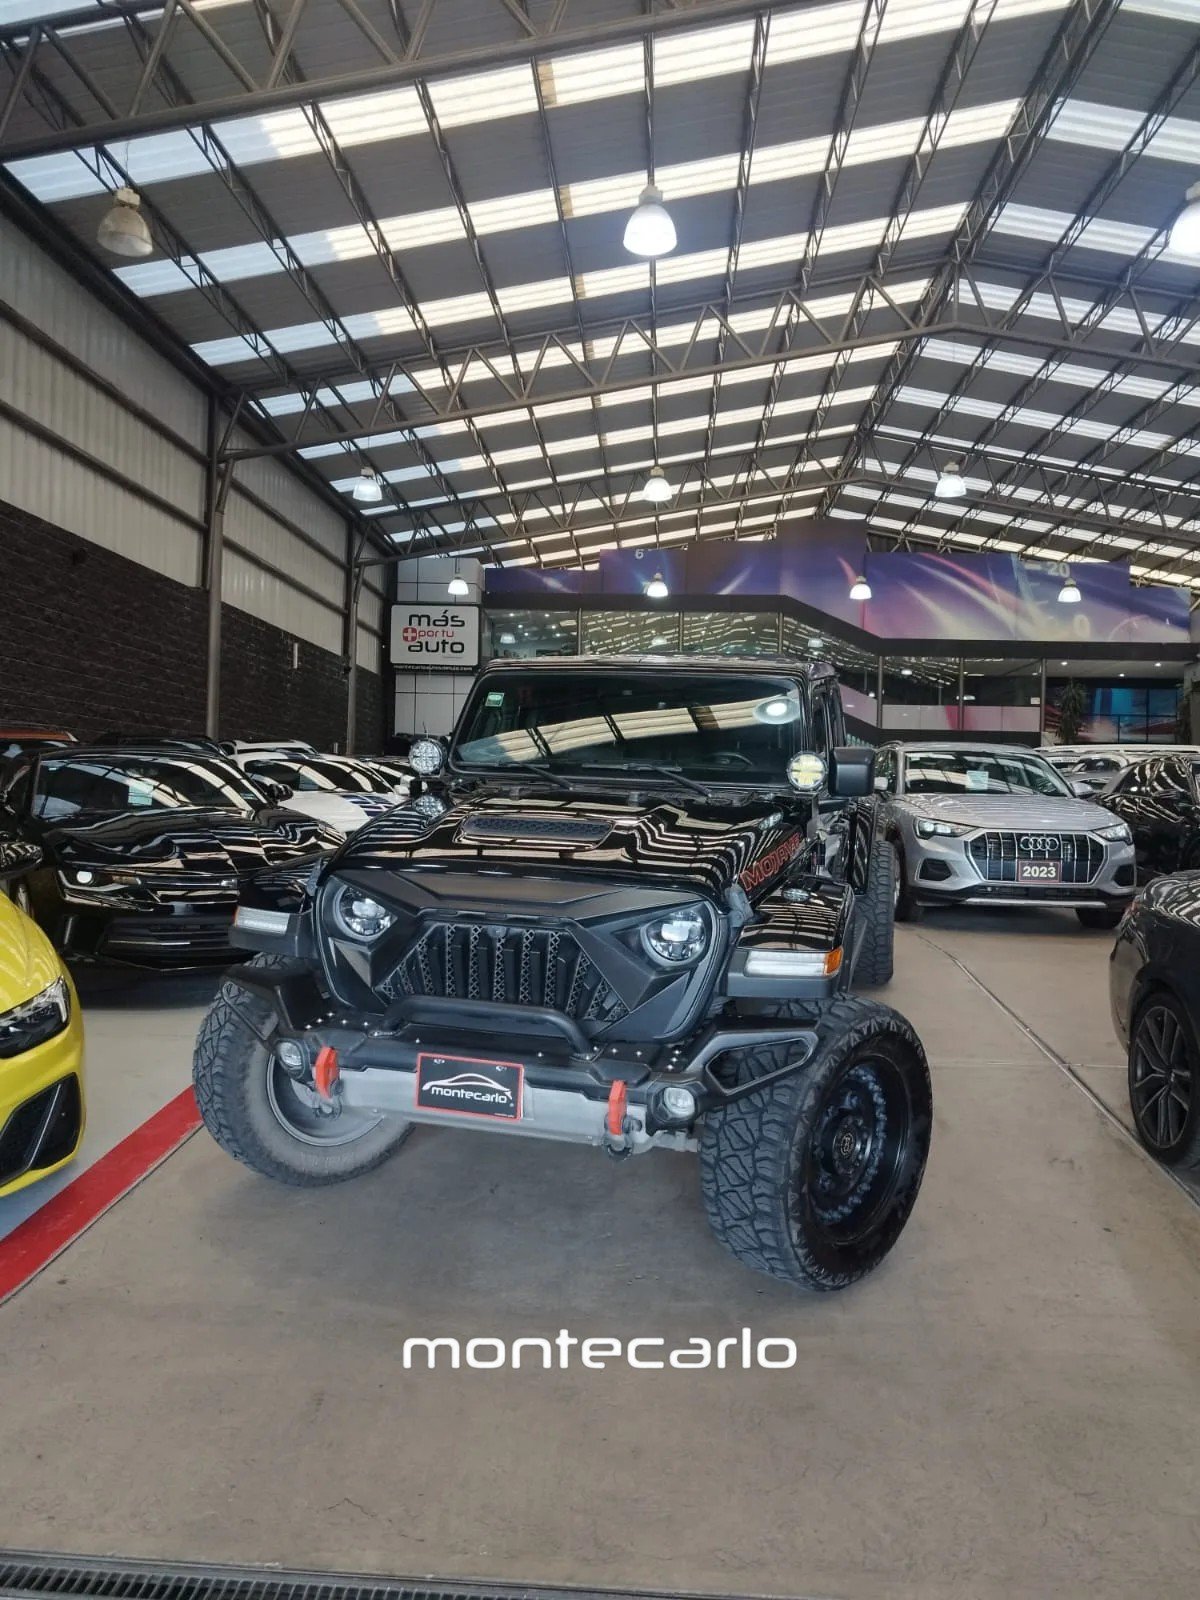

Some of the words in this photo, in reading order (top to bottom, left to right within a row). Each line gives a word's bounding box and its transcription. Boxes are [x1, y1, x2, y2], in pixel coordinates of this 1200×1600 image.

[1047, 562, 1071, 578] 20
[408, 609, 466, 628] más
[407, 640, 465, 654] auto
[1022, 866, 1056, 878] 2023
[431, 1086, 508, 1104] montecarlo
